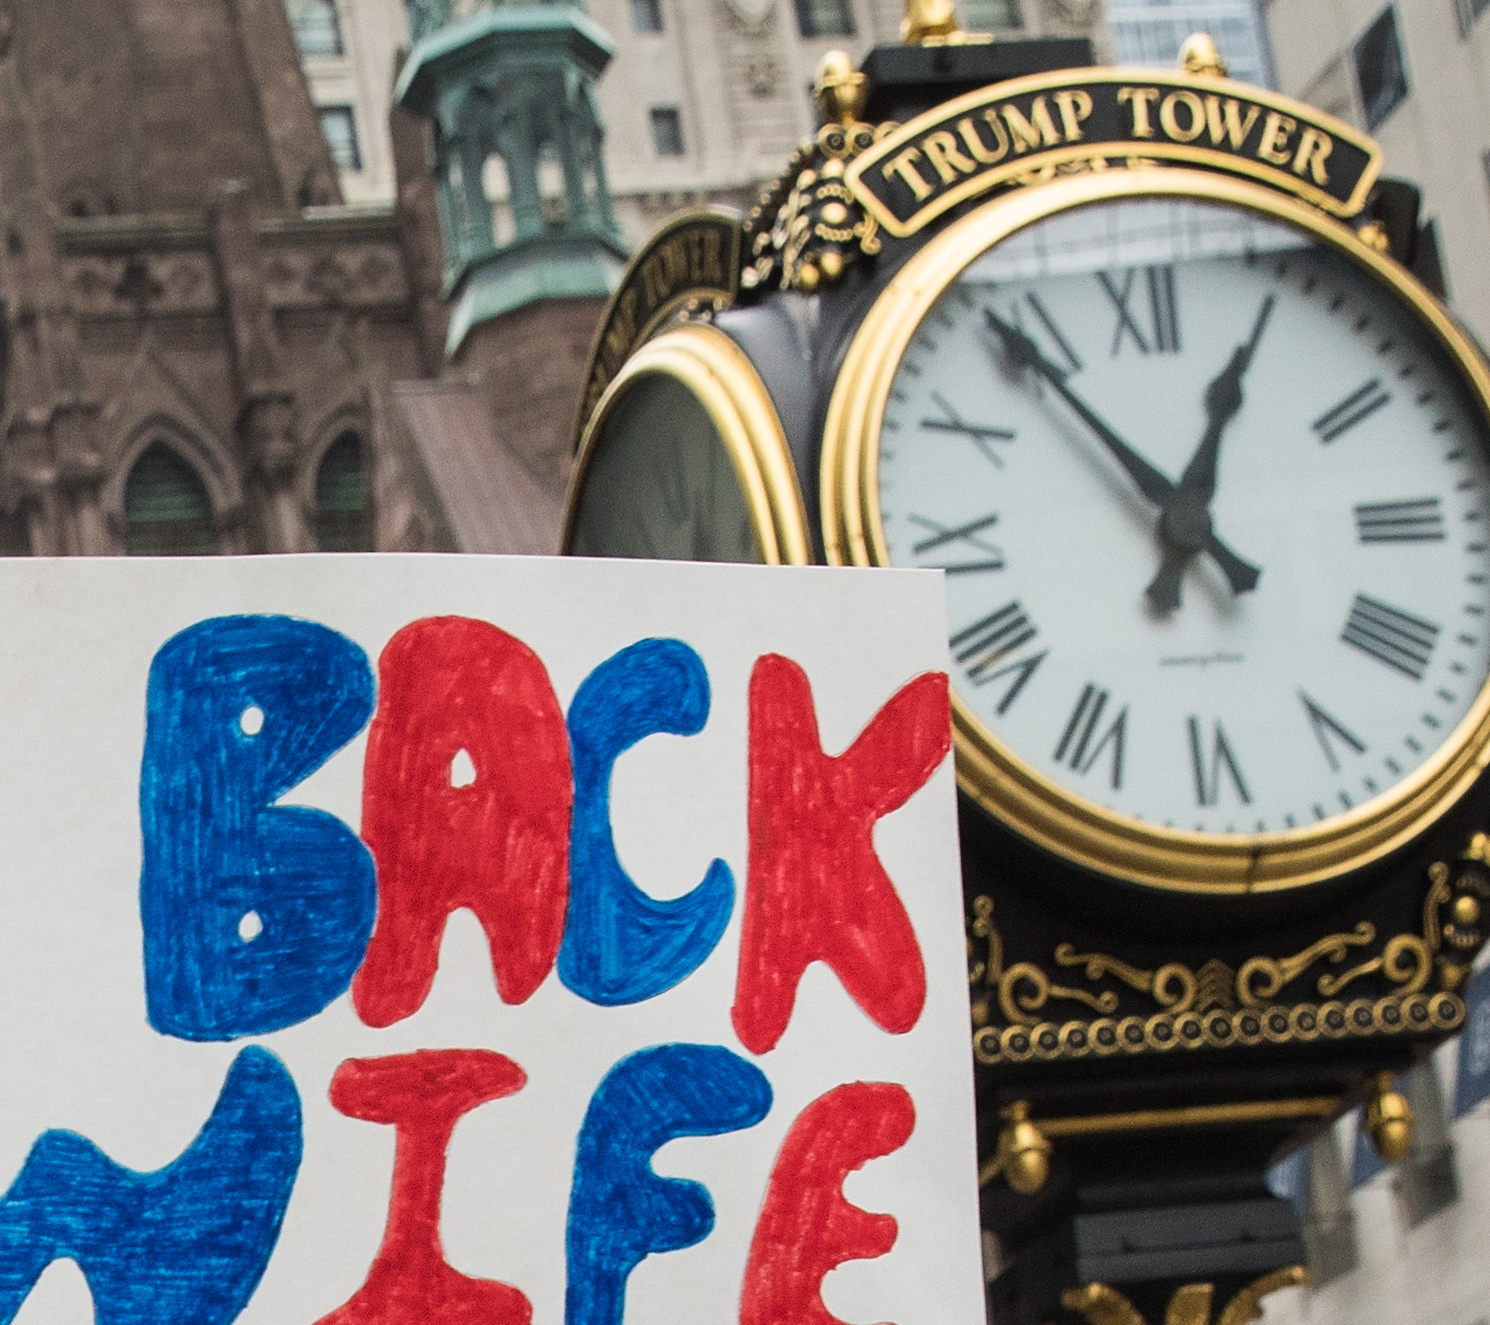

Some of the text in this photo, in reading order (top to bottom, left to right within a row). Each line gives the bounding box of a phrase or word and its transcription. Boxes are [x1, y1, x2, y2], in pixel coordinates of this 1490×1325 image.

[882, 86, 1334, 202] TRUMP TOWER
[139, 614, 950, 1052] BACK
